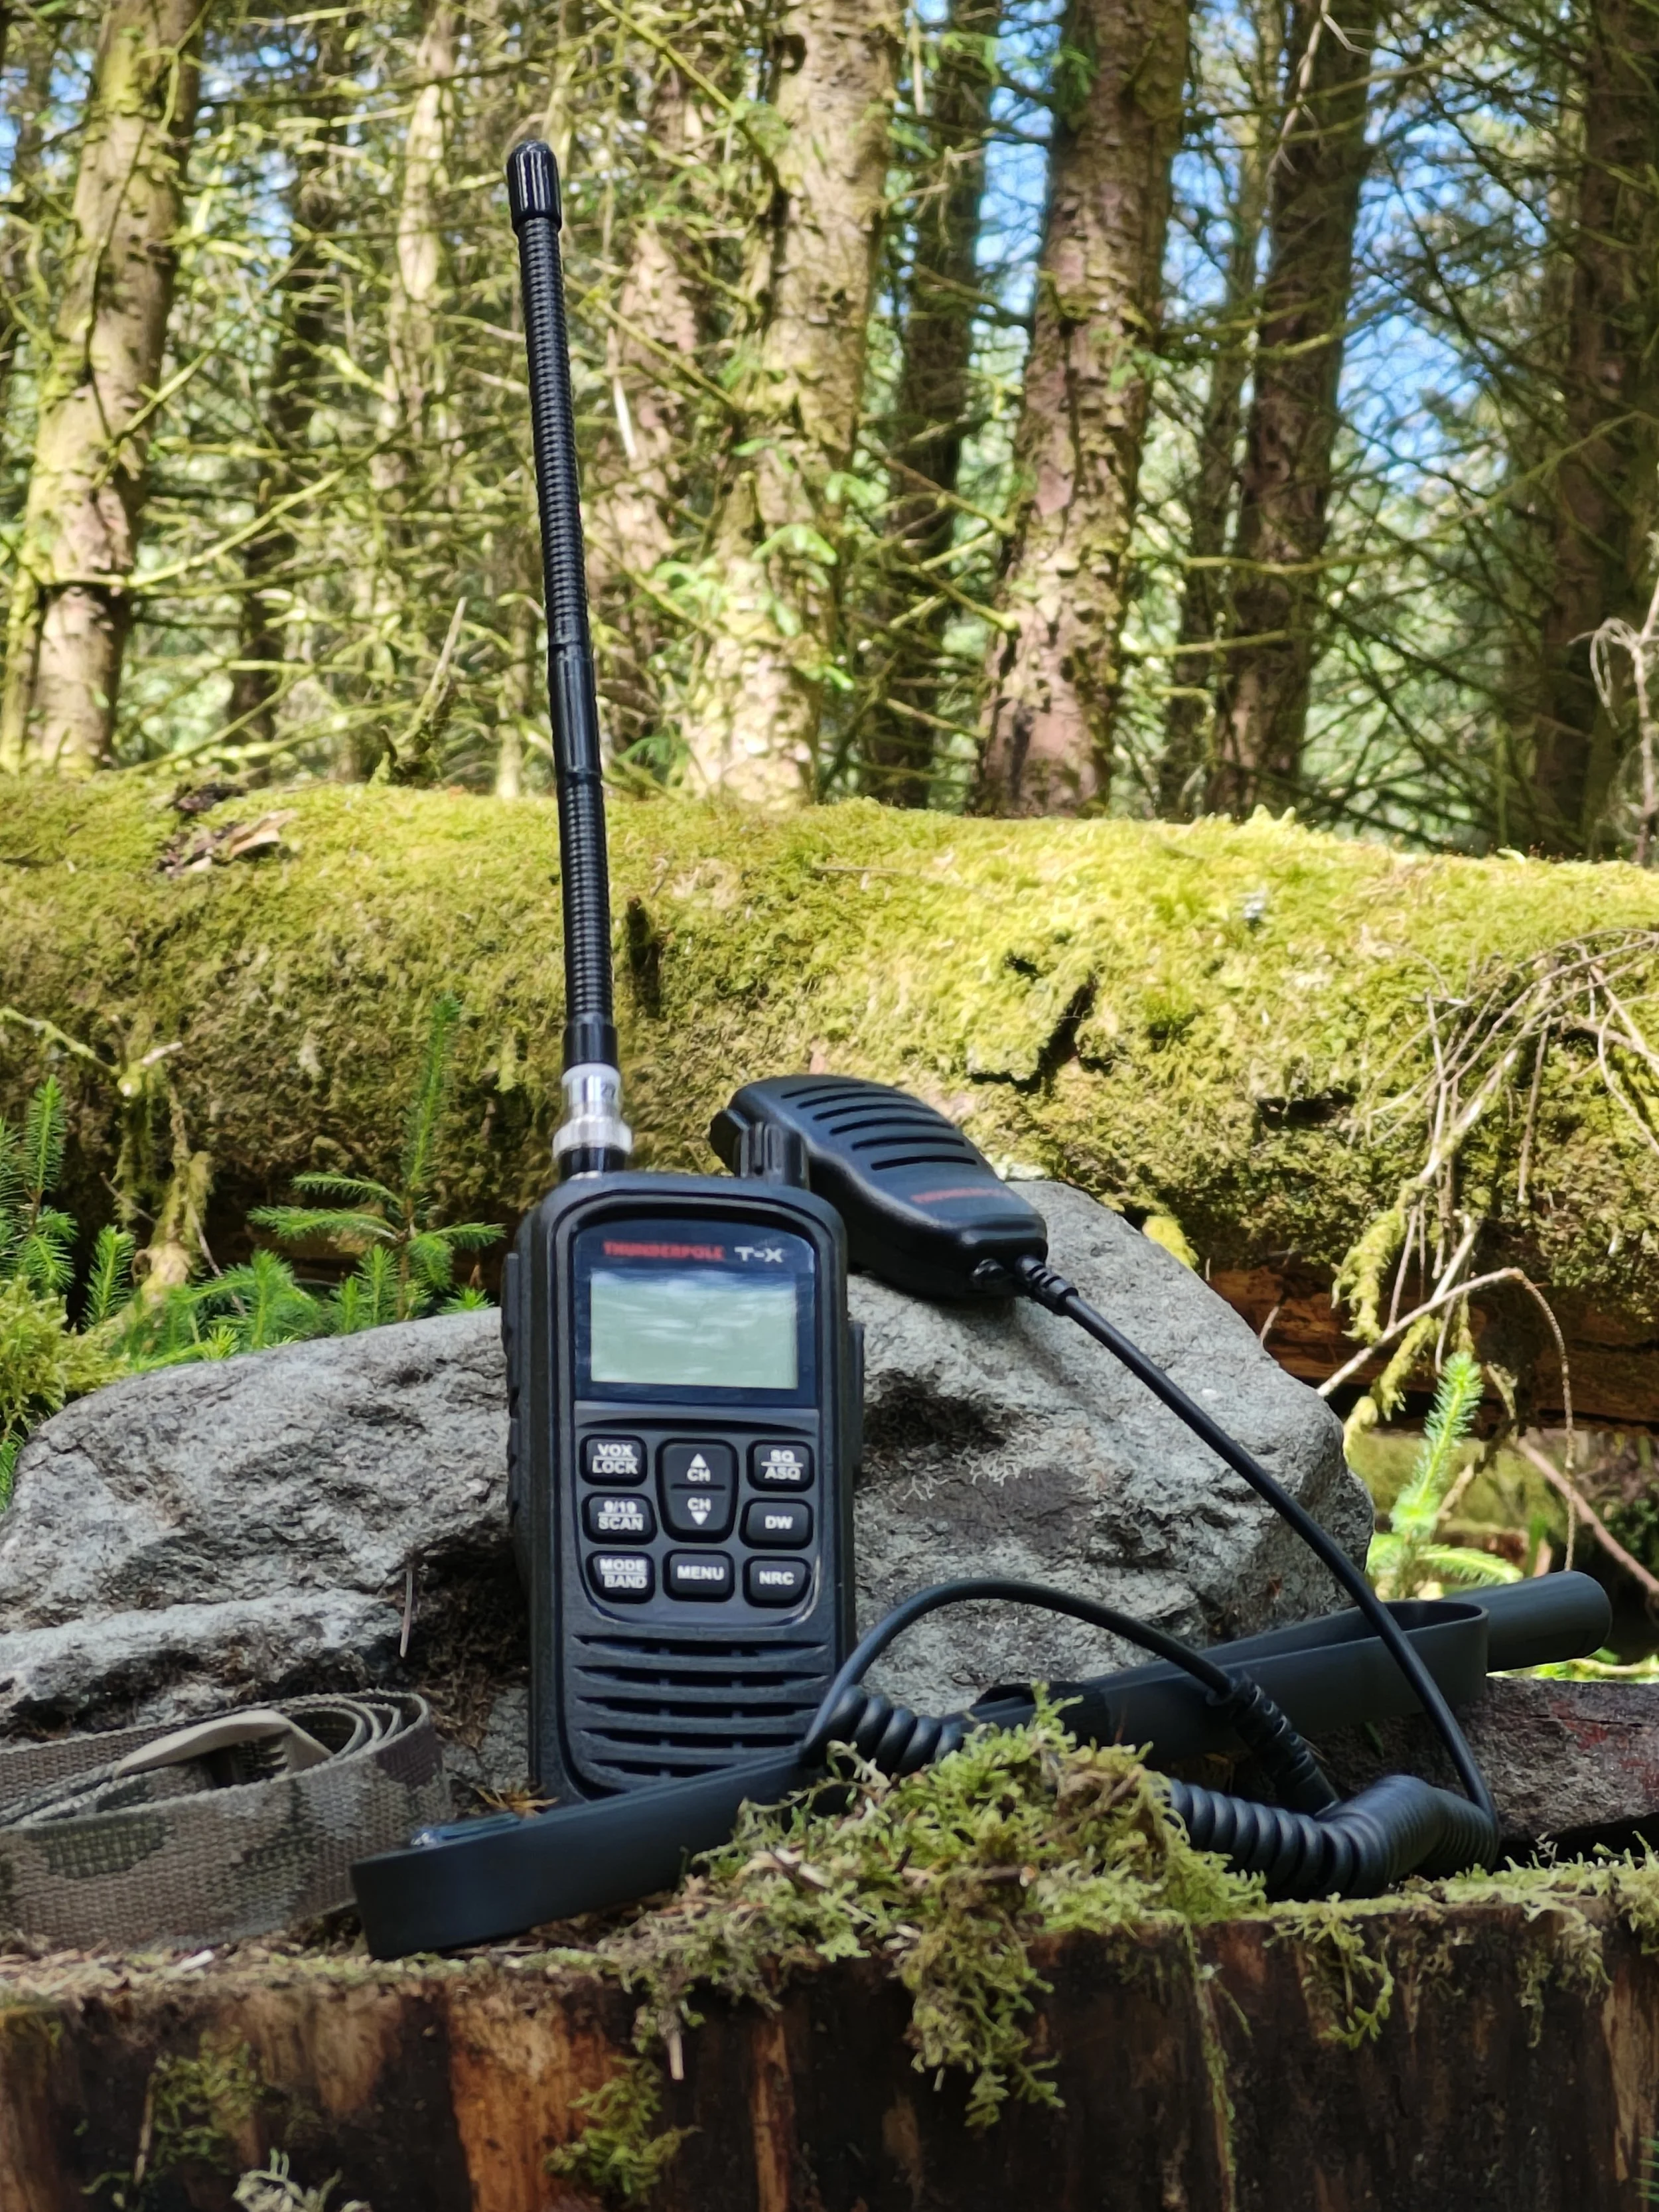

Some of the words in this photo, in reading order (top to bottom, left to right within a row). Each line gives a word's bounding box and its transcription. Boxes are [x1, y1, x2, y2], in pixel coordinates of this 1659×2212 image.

[734, 1246, 784, 1263] T-X
[598, 1443, 633, 1457] VOX
[770, 1449, 795, 1463] SQ
[592, 1459, 638, 1475] LOCK
[764, 1466, 801, 1481] ASQ
[686, 1468, 711, 1482] CH
[604, 1501, 638, 1514] 9/19
[687, 1498, 711, 1512] CH
[598, 1516, 643, 1531] SCAN
[764, 1516, 793, 1530] DW
[599, 1558, 647, 1573] MODE
[677, 1565, 725, 1581] MENU
[604, 1574, 648, 1589] BAND
[758, 1570, 794, 1585] NRC
